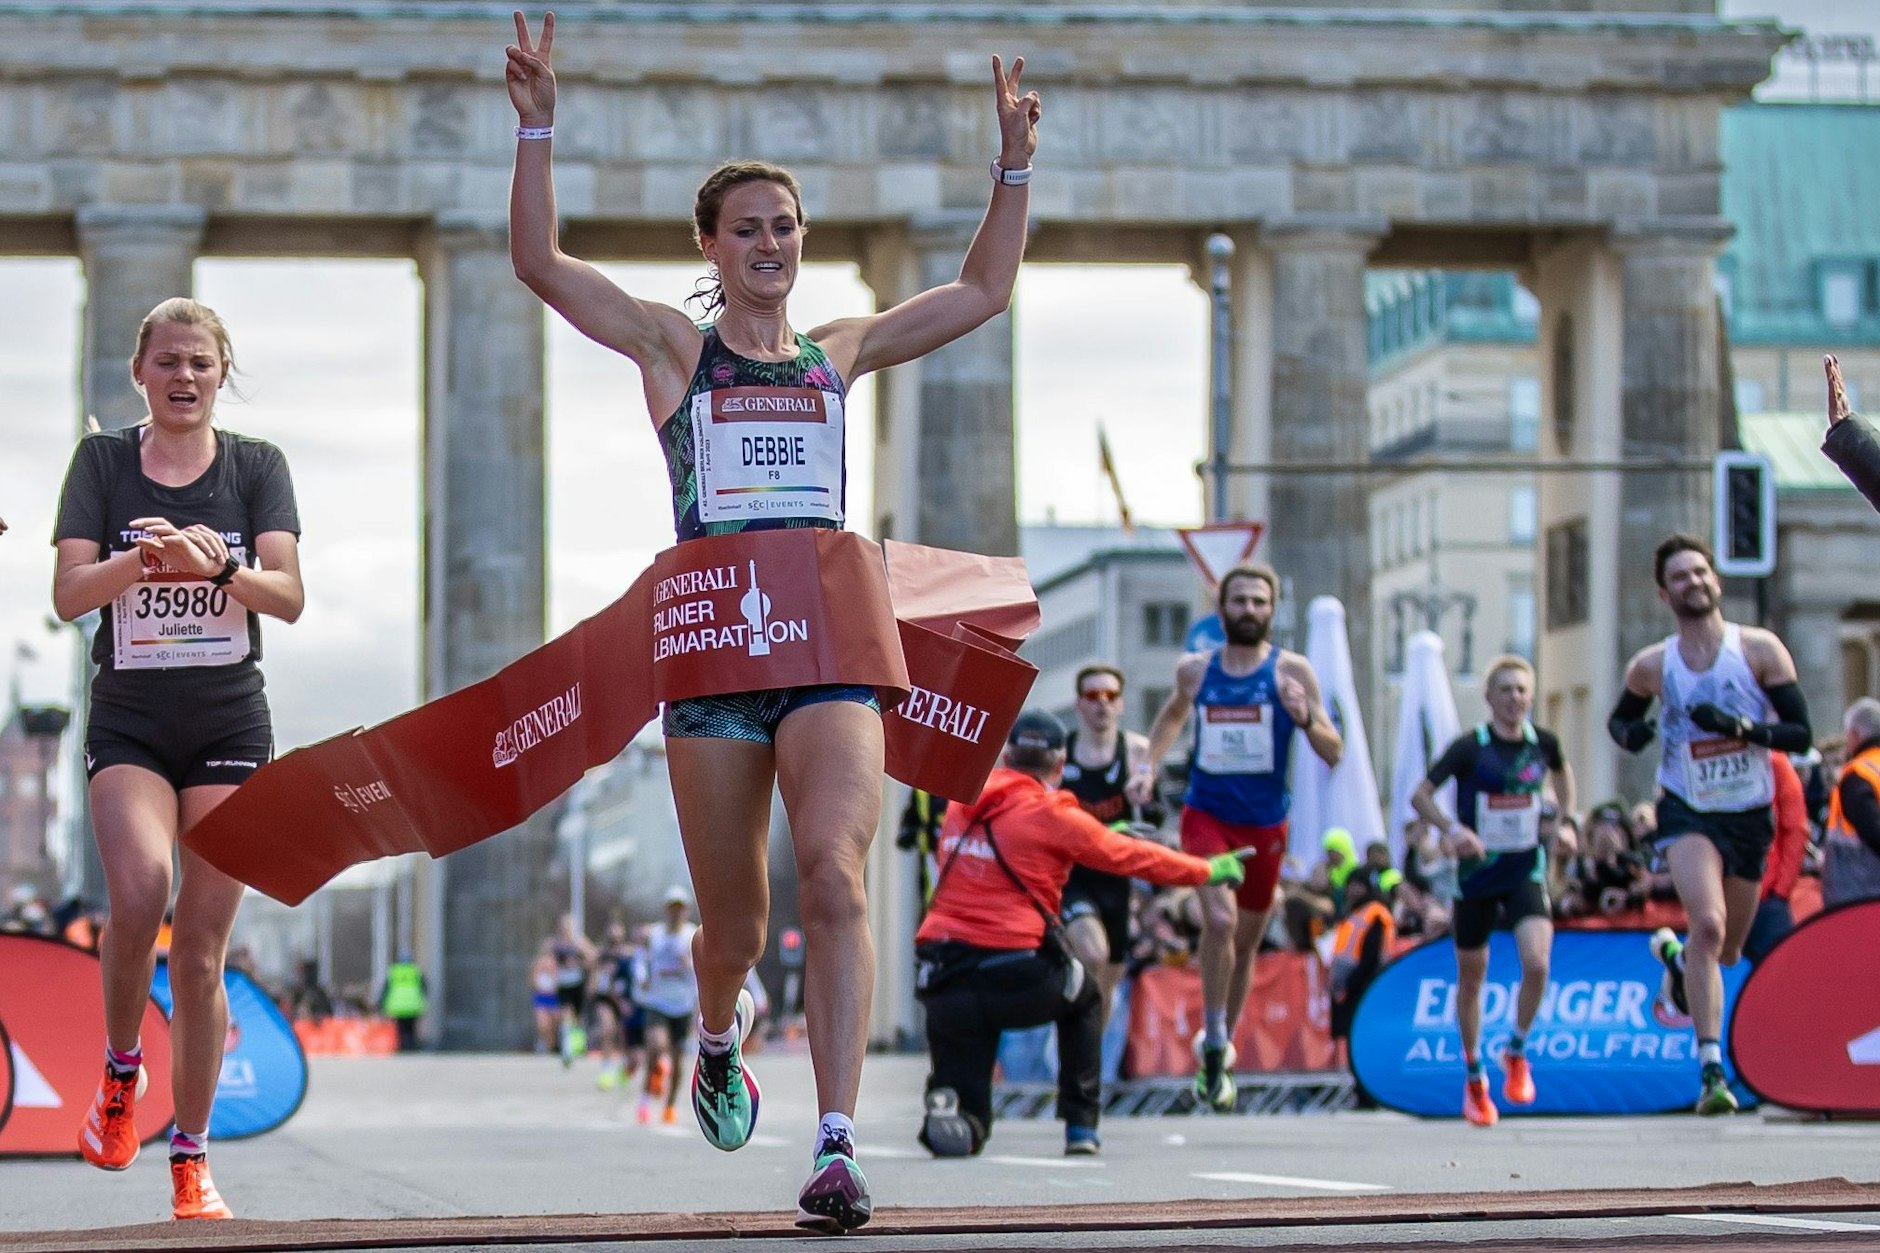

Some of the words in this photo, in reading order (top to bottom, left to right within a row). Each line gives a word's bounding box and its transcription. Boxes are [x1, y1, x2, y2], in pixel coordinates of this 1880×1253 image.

[745, 397, 816, 412] GENERALI
[742, 437, 805, 466] DEBBIE
[768, 470, 780, 480] F8
[656, 566, 738, 604] GENERALI
[135, 586, 228, 619] 35980
[158, 623, 203, 636] Juliette
[512, 682, 583, 754] GENERALI
[894, 684, 991, 744] ERALI
[356, 780, 391, 804] EVEN
